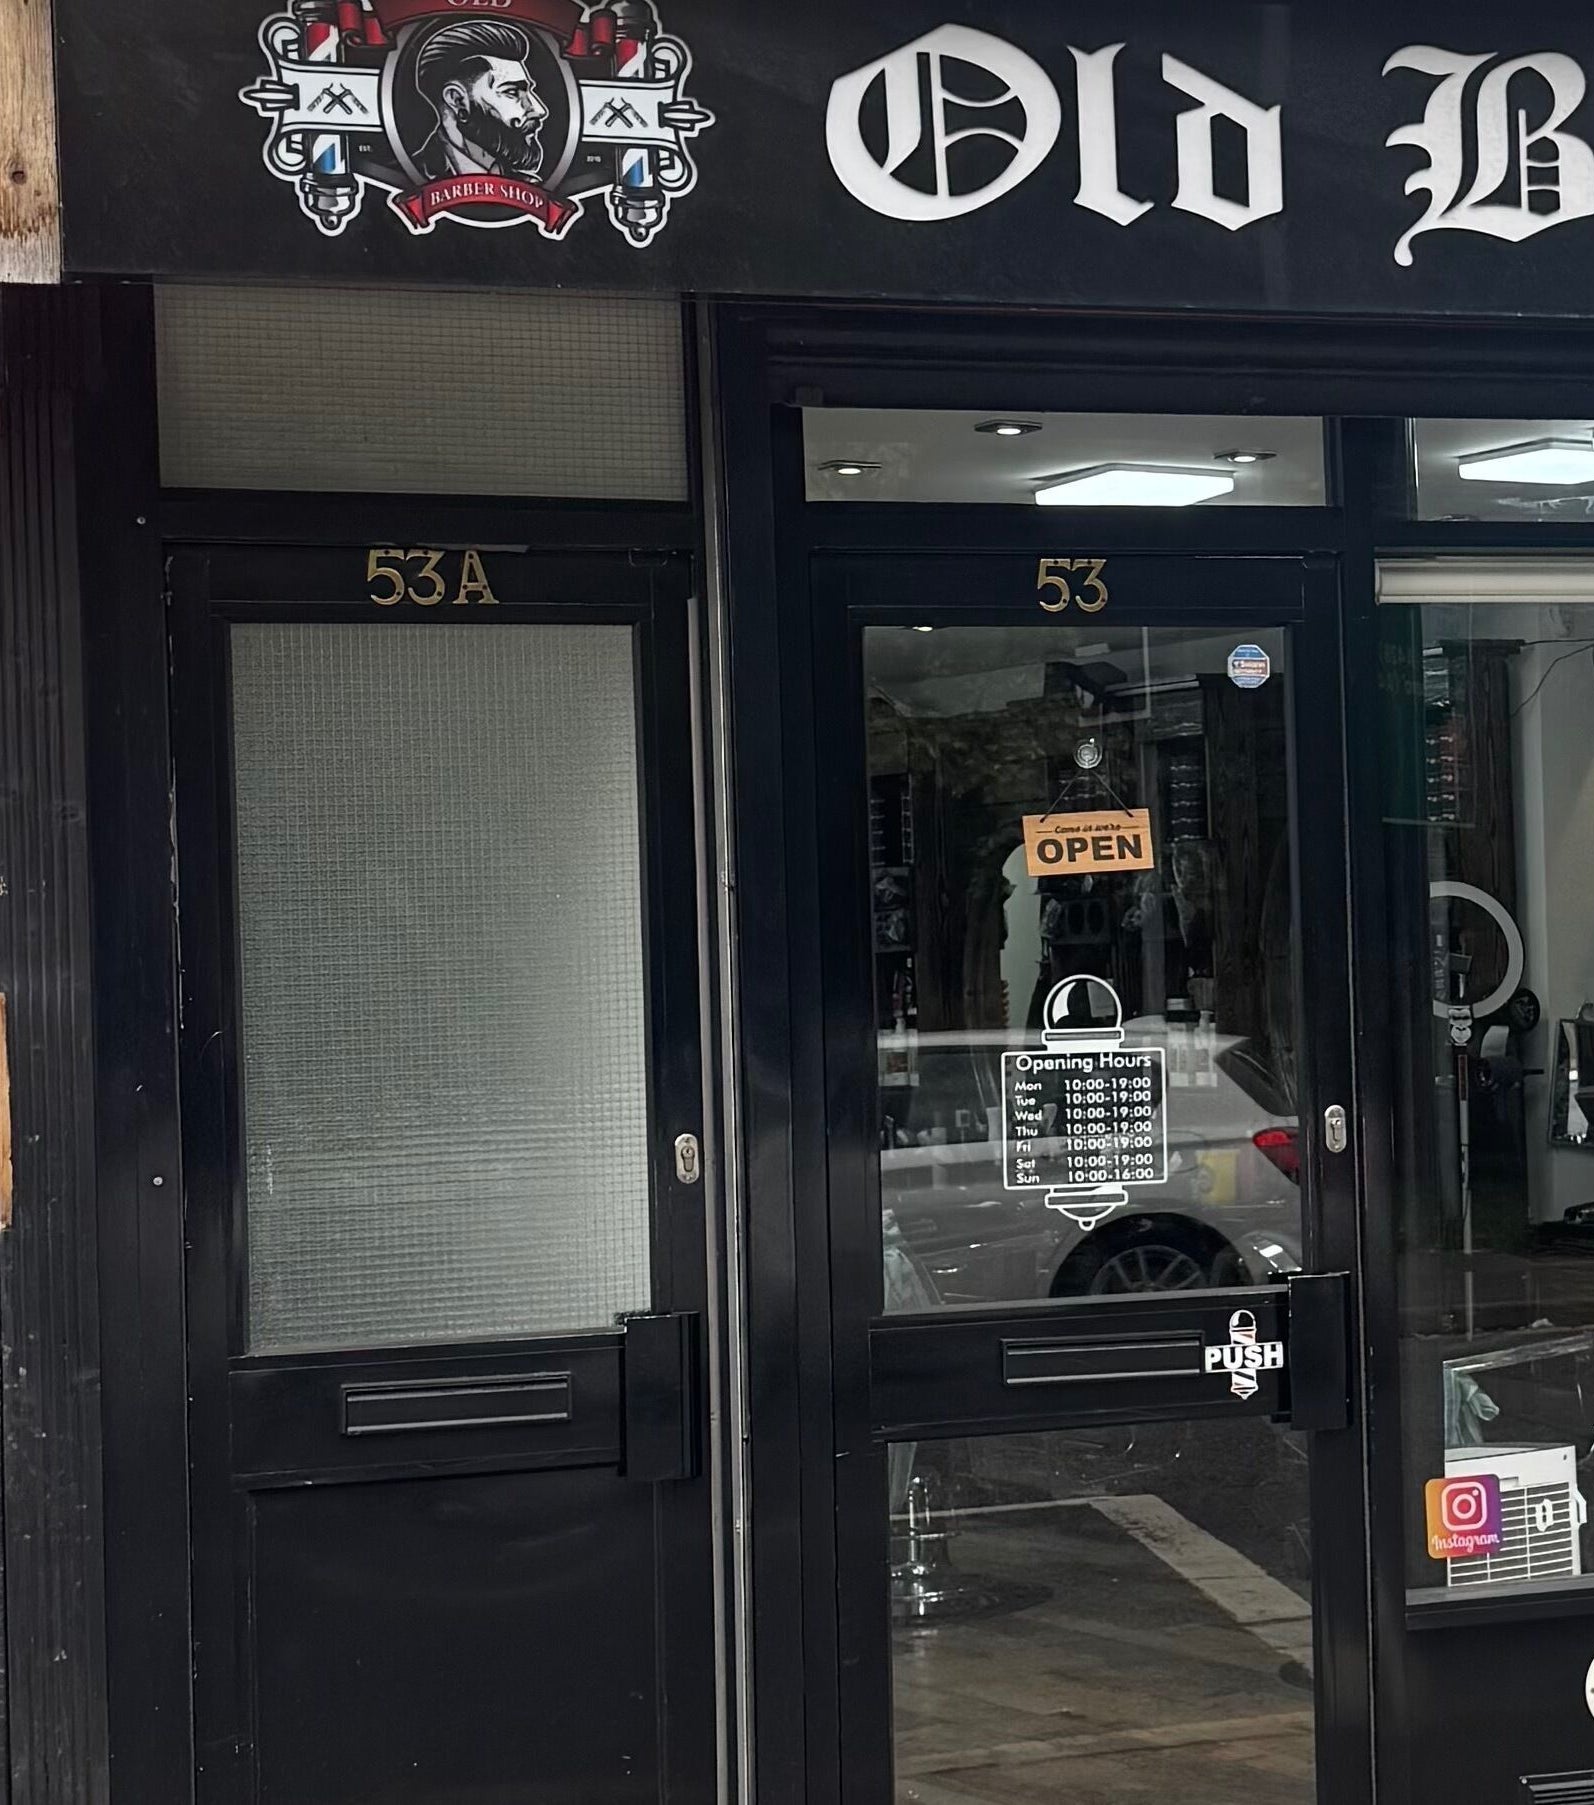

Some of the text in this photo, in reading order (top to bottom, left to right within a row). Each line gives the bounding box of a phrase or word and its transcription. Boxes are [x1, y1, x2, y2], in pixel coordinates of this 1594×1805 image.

[826, 24, 1283, 232] Old
[430, 182, 543, 209] BARBER SHOP
[1037, 558, 1108, 613] 53
[1037, 834, 1143, 864] OPEN
[1015, 1052, 1152, 1075] Opening Hours
[1014, 1077, 1151, 1091] Mon 10:00-19:00
[1015, 1091, 1151, 1106] Tue 10:00-19:00
[1015, 1106, 1151, 1121] Wed 10:00-19:00
[1015, 1121, 1152, 1137] Thu 10:00-19:00
[1016, 1140, 1031, 1153] Fri
[1016, 1154, 1153, 1169] Sat 10:00-19:00
[1016, 1172, 1040, 1184] Sun
[1205, 1343, 1283, 1373] PUSH
[1432, 1533, 1500, 1552] Instagram
